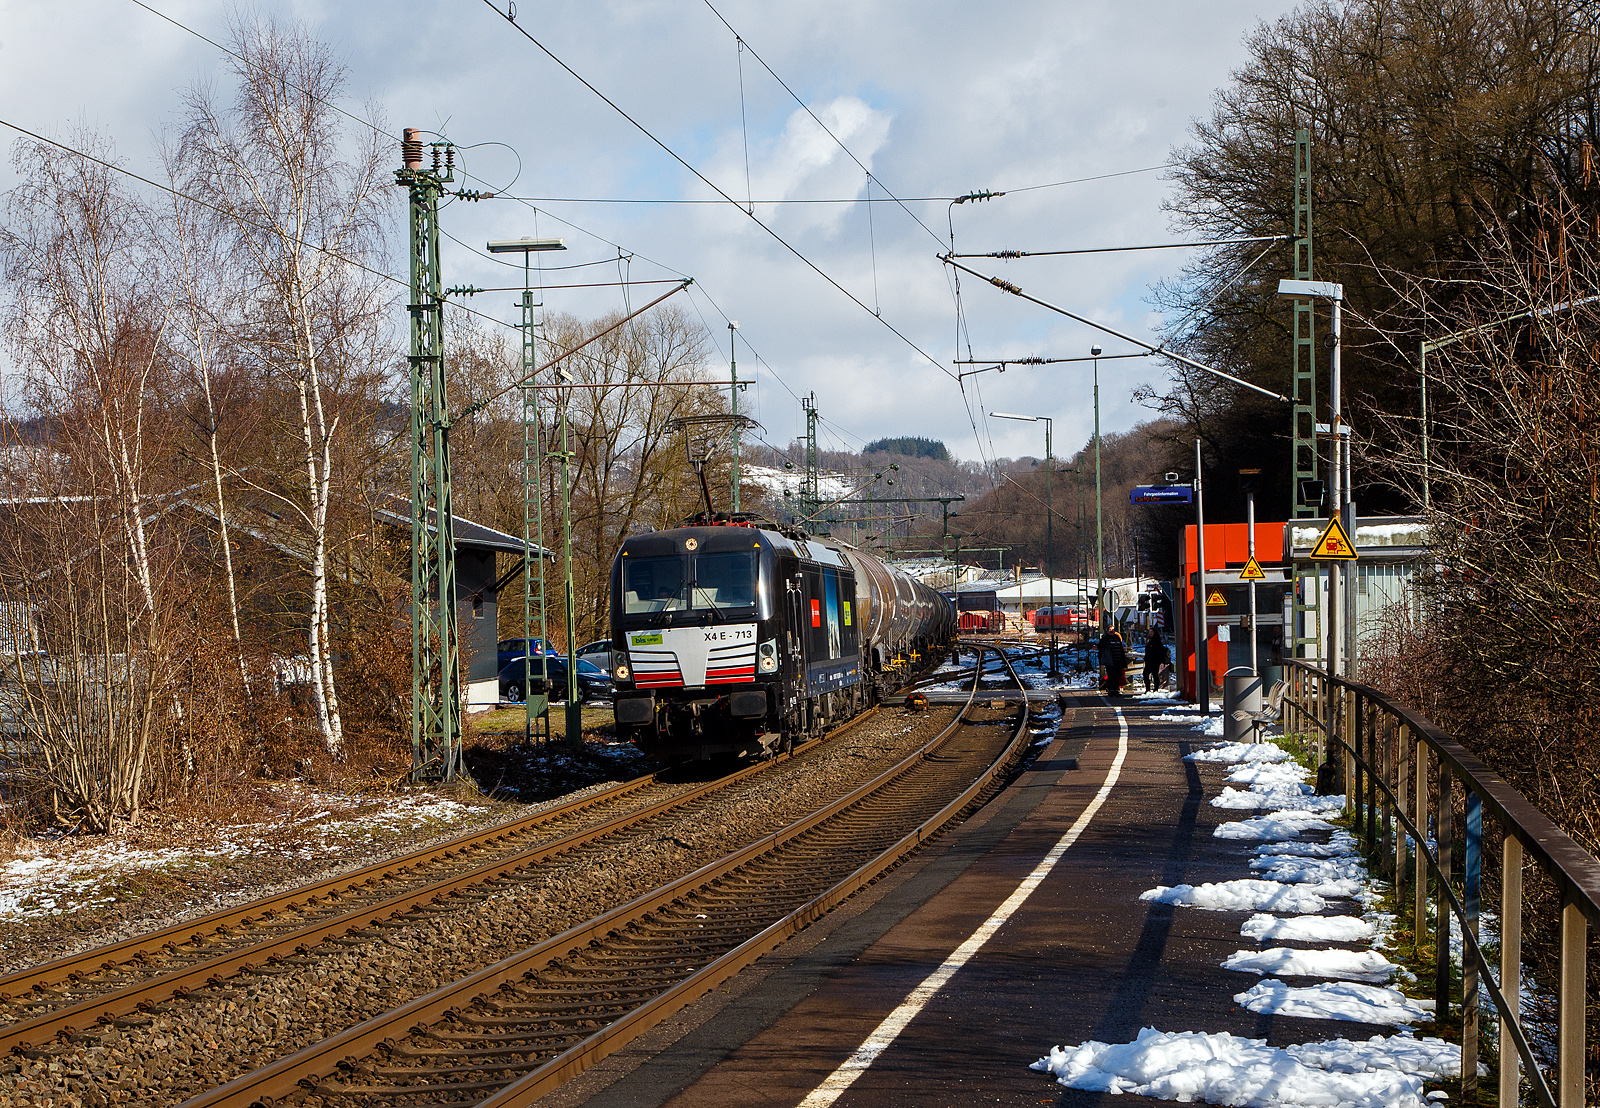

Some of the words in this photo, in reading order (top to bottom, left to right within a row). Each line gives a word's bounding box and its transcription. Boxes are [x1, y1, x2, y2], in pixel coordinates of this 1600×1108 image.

[704, 632, 718, 641] X4
[720, 631, 726, 640] E
[735, 630, 752, 639] 713
